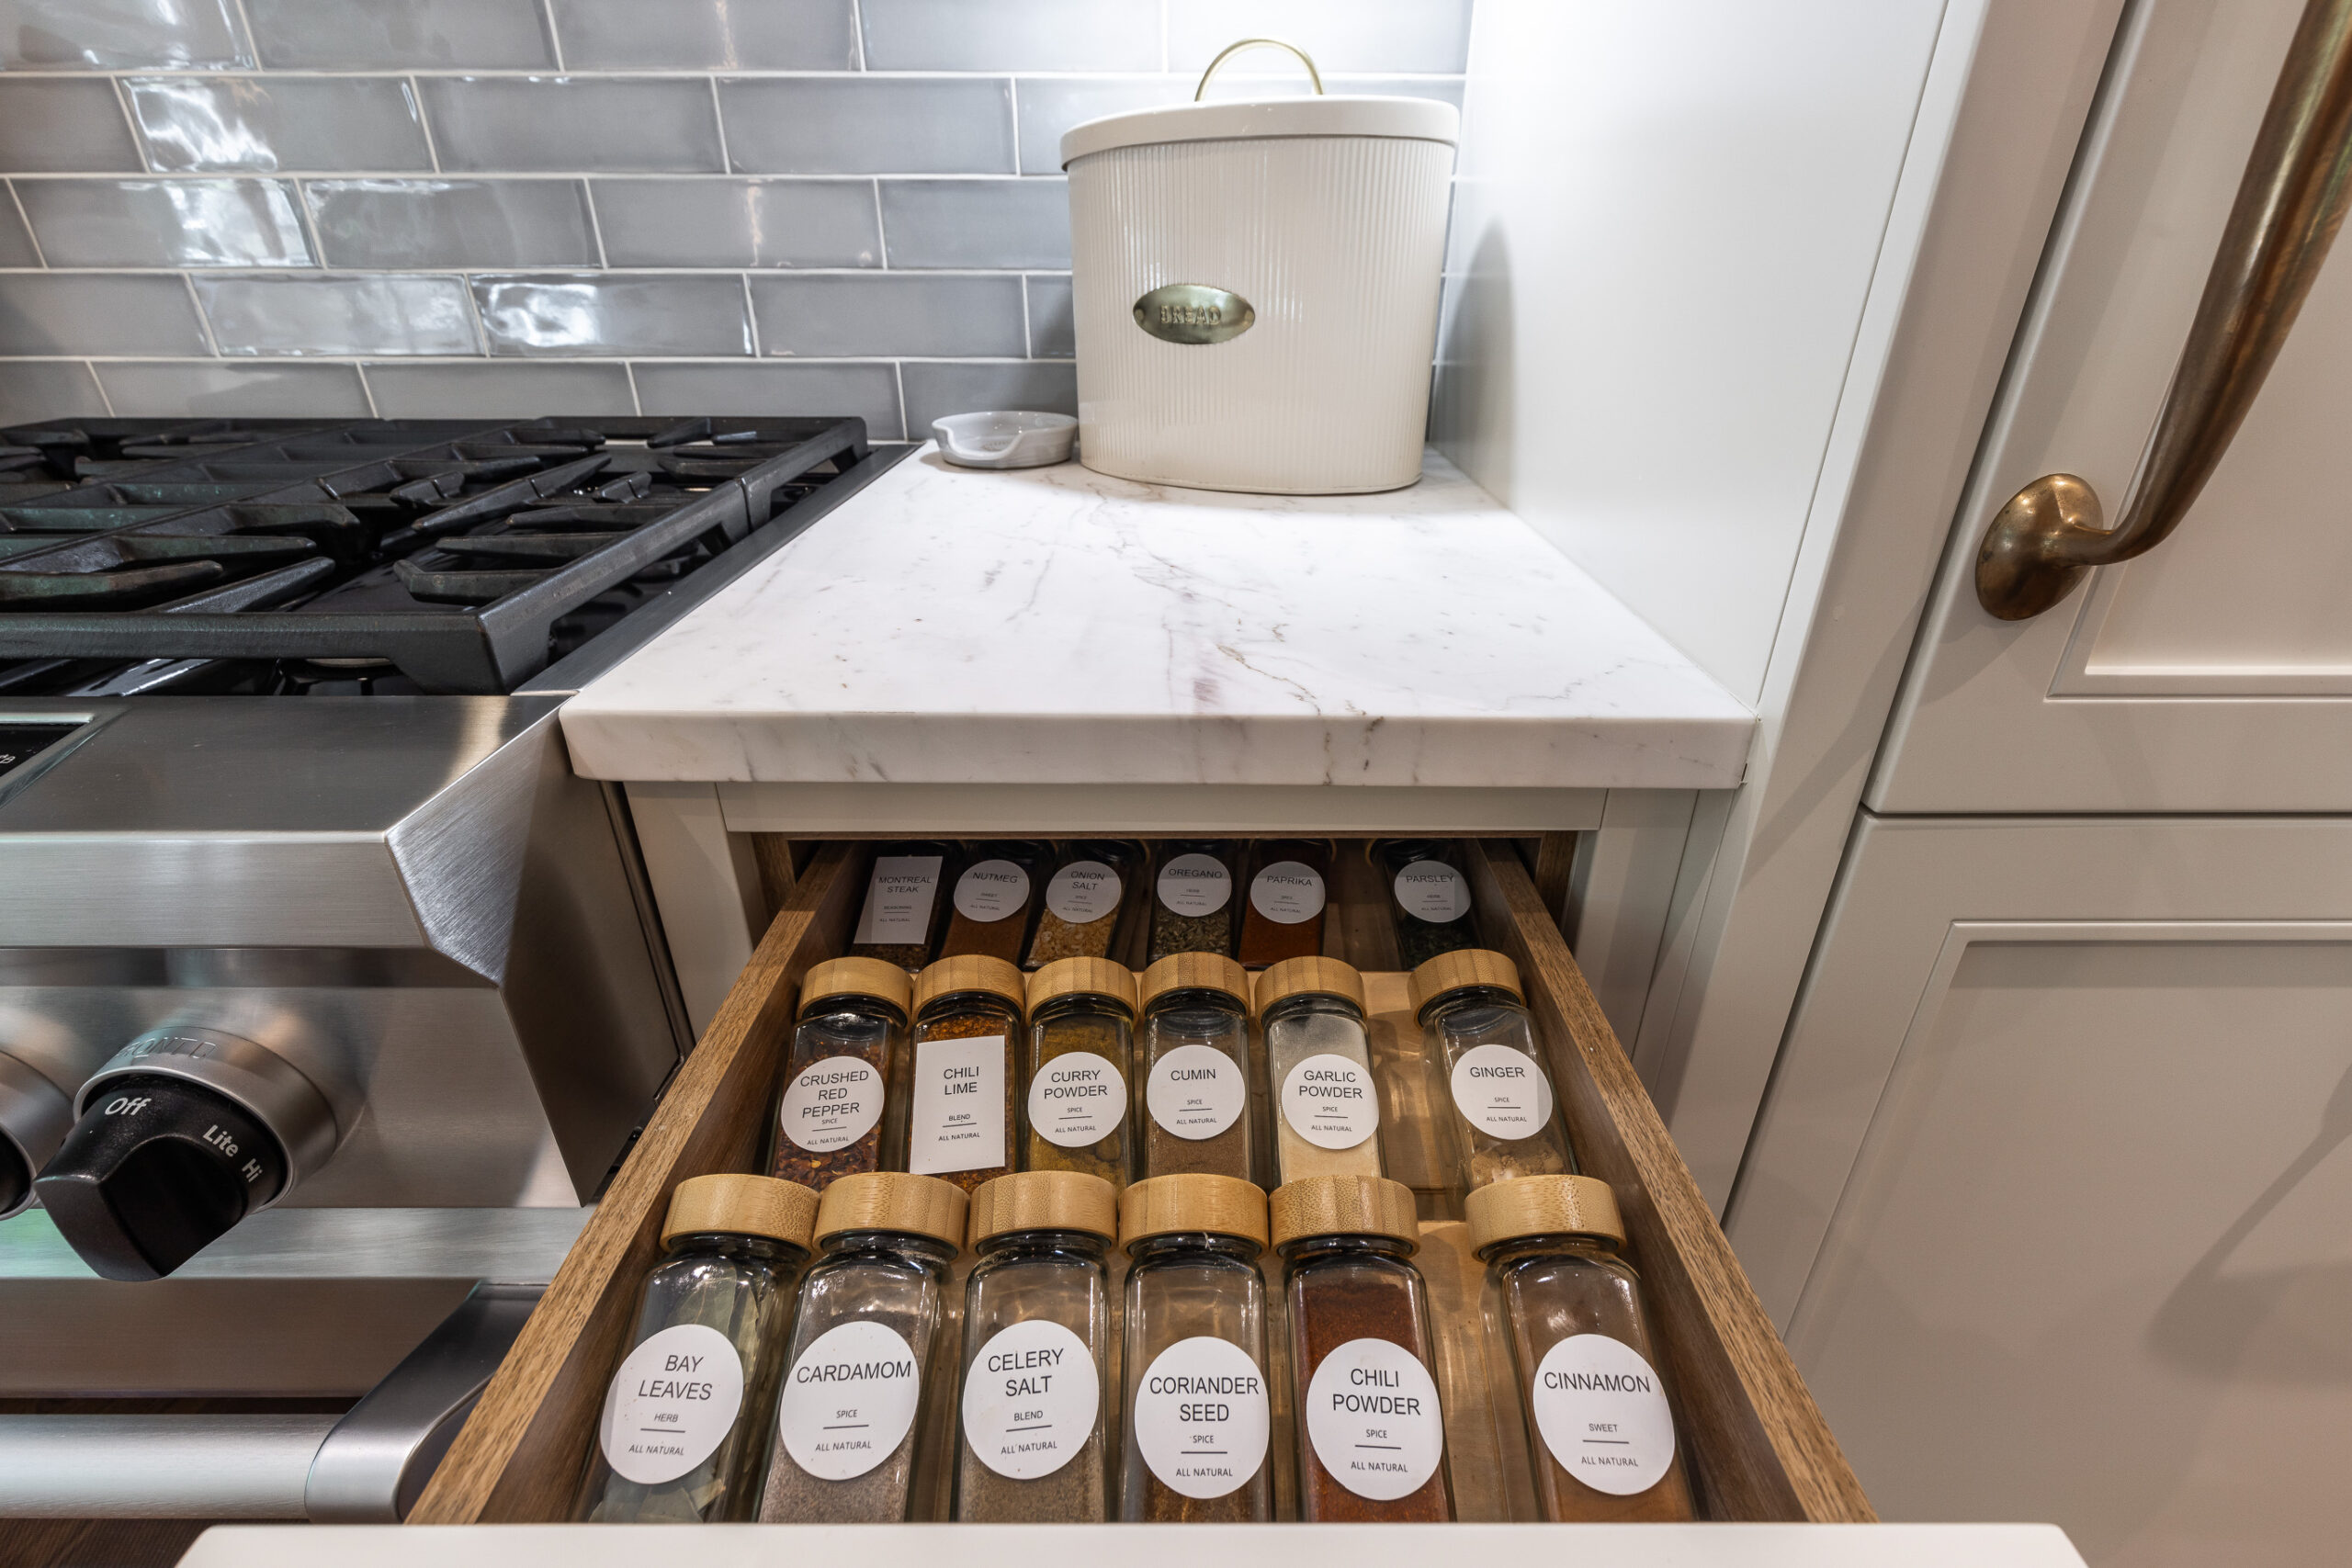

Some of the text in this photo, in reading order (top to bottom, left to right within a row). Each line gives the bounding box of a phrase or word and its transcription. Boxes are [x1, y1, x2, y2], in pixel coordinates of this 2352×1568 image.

[1160, 305, 1222, 325] BREAD
[879, 875, 932, 885] MONTREAL
[973, 871, 1018, 884] NUTMEG
[1071, 870, 1104, 881] ONION
[1169, 868, 1222, 879] OREGANO
[1406, 874, 1454, 884] PARSLEY
[1072, 881, 1098, 891] SALT
[1267, 875, 1312, 886] PAPRIKA
[888, 886, 919, 894] STEAK
[944, 1066, 979, 1080] CHILI
[1051, 1070, 1101, 1084] CURRY
[1170, 1068, 1216, 1081] CUMIN
[1304, 1070, 1356, 1083] GARLIC
[1470, 1066, 1526, 1078] GINGER
[800, 1069, 869, 1089] CRUSHED
[818, 1088, 848, 1101] RED
[944, 1082, 978, 1096] LIME
[1044, 1085, 1108, 1100] POWDER
[1299, 1085, 1363, 1100] POWDER
[105, 1097, 152, 1115] Off
[802, 1101, 861, 1120] PEPPER
[948, 1113, 971, 1122] BLEND
[1176, 1117, 1217, 1126] ALL NATURAL
[1498, 1115, 1527, 1123] NATURAL
[1068, 1125, 1096, 1134] NATURAL
[1324, 1124, 1352, 1133] NATURAL
[202, 1124, 239, 1157] Lite
[808, 1135, 850, 1146] ALL NATURAL
[952, 1132, 980, 1141] NATURAL
[242, 1158, 263, 1182] Hi
[665, 1354, 704, 1373] BAY
[988, 1348, 1065, 1373] CELERY
[797, 1360, 912, 1384] CARDAMOM
[1350, 1368, 1400, 1388] CHILI
[1005, 1375, 1053, 1397] SALT
[1149, 1376, 1260, 1395] CORIANDER
[1544, 1371, 1651, 1394] CINNAMON
[639, 1381, 713, 1402] LEAVES
[1333, 1394, 1421, 1417] POWDER
[654, 1413, 679, 1423] HERB
[836, 1409, 858, 1419] SPICE
[1014, 1410, 1044, 1422] BLEND
[1180, 1404, 1230, 1423] SEED
[1366, 1428, 1388, 1439] SPICE
[1589, 1423, 1619, 1433] SWEET
[816, 1440, 872, 1452] ALL NATURAL
[1193, 1434, 1215, 1445] SPICE
[628, 1444, 684, 1456] ALL NATURAL
[1001, 1441, 1057, 1455] ALL NATURAL
[1351, 1461, 1408, 1473] ALL NATURAL
[1581, 1455, 1639, 1468] ALL NATURAL
[1176, 1467, 1233, 1478] ALL NATURAL
